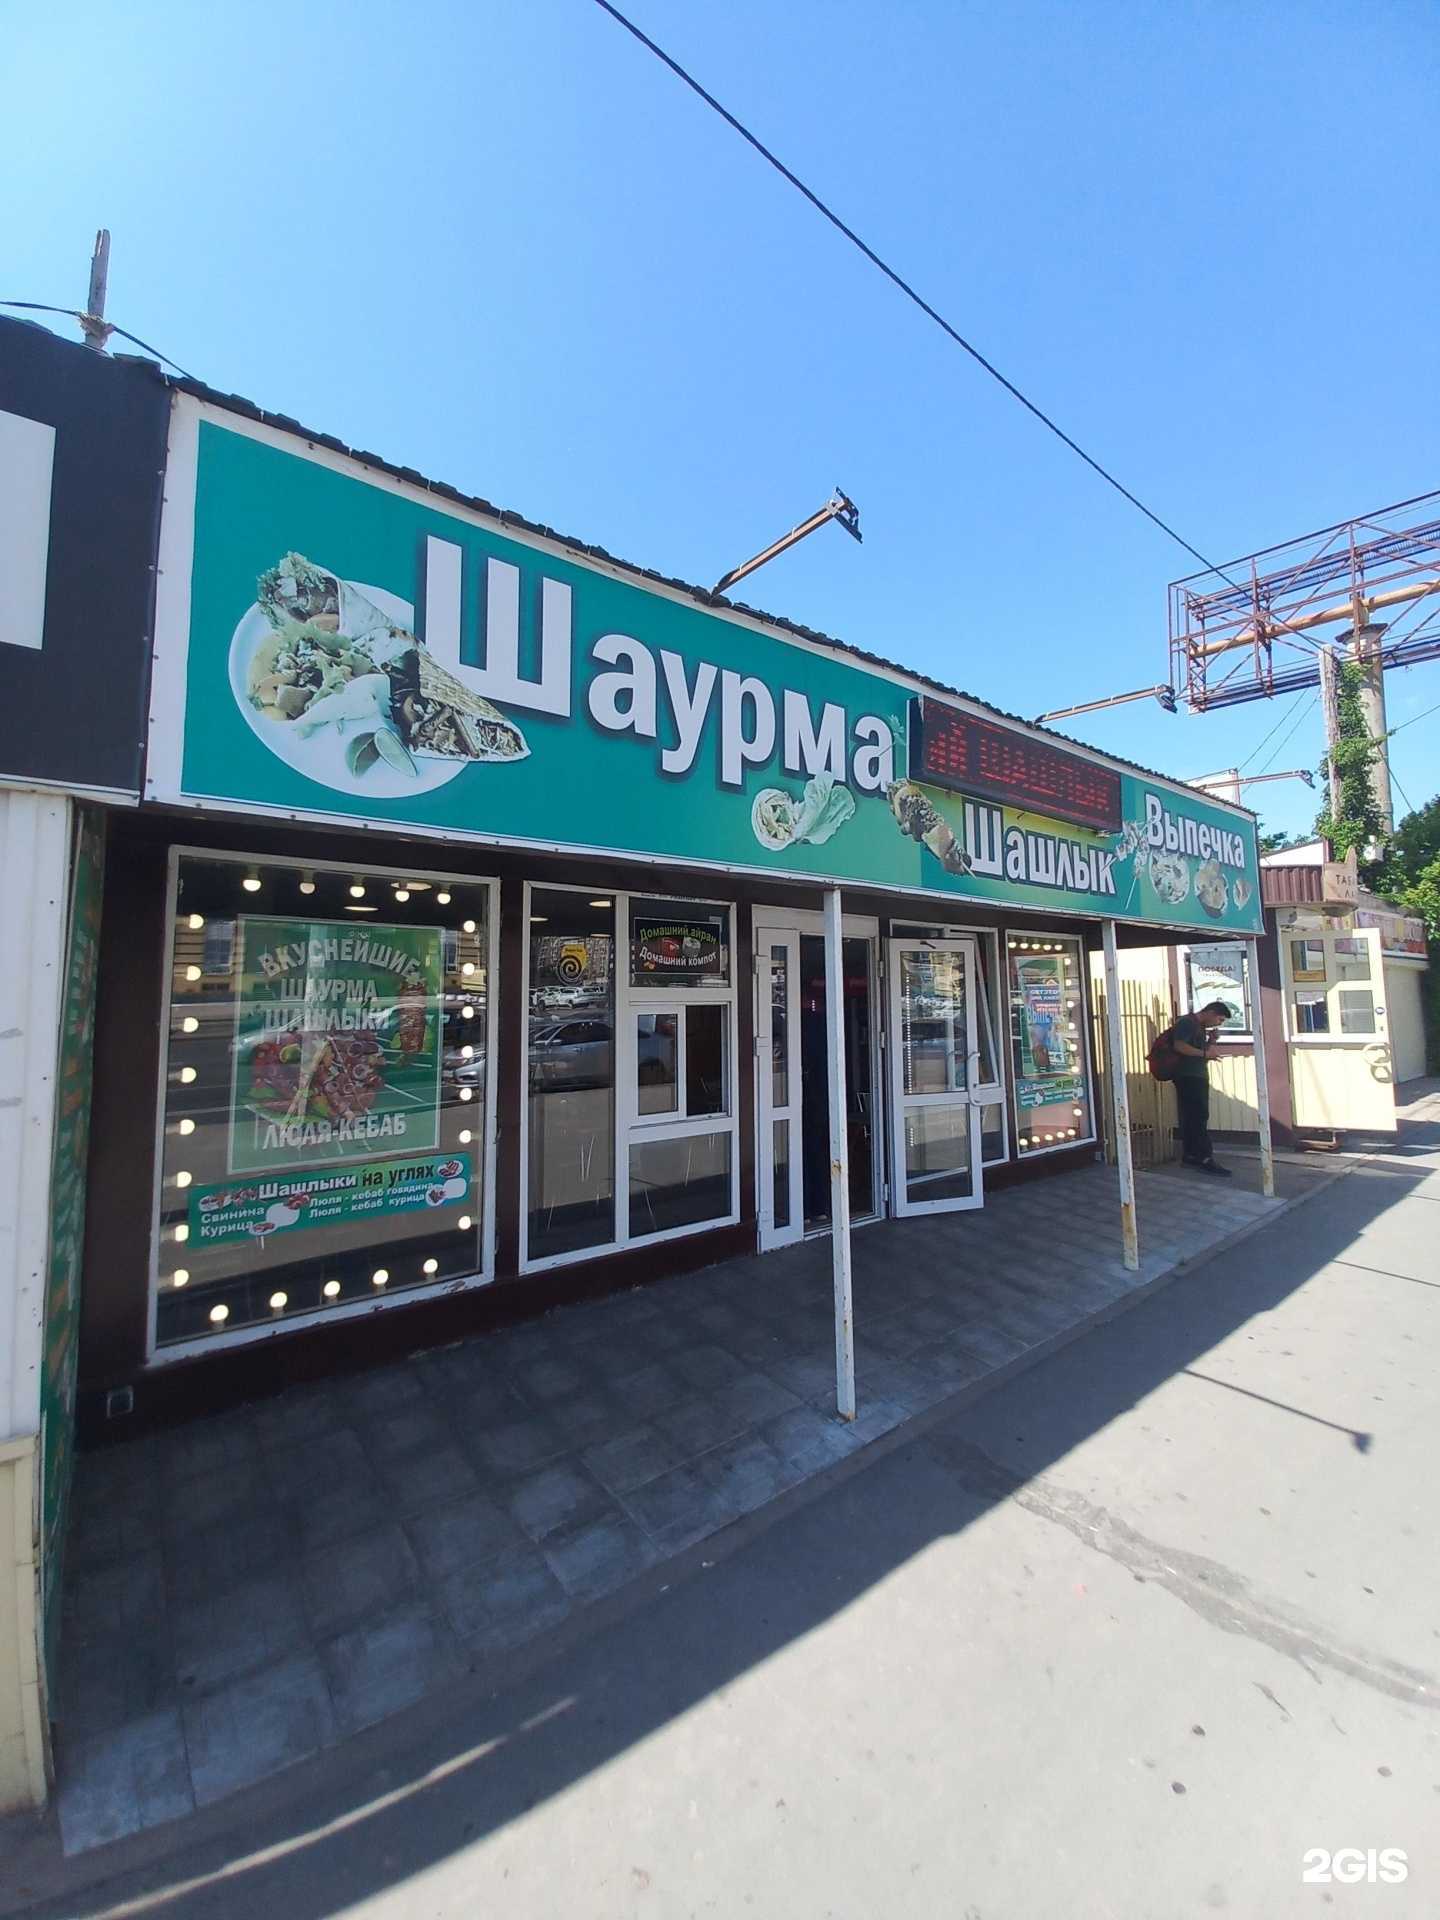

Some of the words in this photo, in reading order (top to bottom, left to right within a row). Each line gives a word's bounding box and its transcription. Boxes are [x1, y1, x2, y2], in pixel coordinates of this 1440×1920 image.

[426, 535, 894, 792] Шаурма
[1145, 794, 1245, 868] Выпечка
[965, 801, 1116, 895] Шашлык
[640, 925, 689, 941] Домашний
[691, 928, 717, 944] айран
[258, 928, 421, 977] ВКУСНЕЙШИЕ
[640, 946, 687, 966] Домашний
[689, 951, 717, 966] компот
[281, 978, 379, 1001] ШАУРМА
[265, 1007, 391, 1031] ШАШЛЫКИ
[258, 1175, 357, 1198] Шашлыки
[362, 1171, 383, 1187] на
[389, 1165, 434, 1187] углях
[309, 1195, 342, 1208] Люля
[352, 1187, 385, 1200] кебаб
[387, 1182, 432, 1195] говядина
[309, 1207, 342, 1219] Люля
[351, 1198, 384, 1211] кебаб
[389, 1194, 425, 1207] курица
[201, 1207, 265, 1223] Свинина
[201, 1221, 254, 1238] Курица
